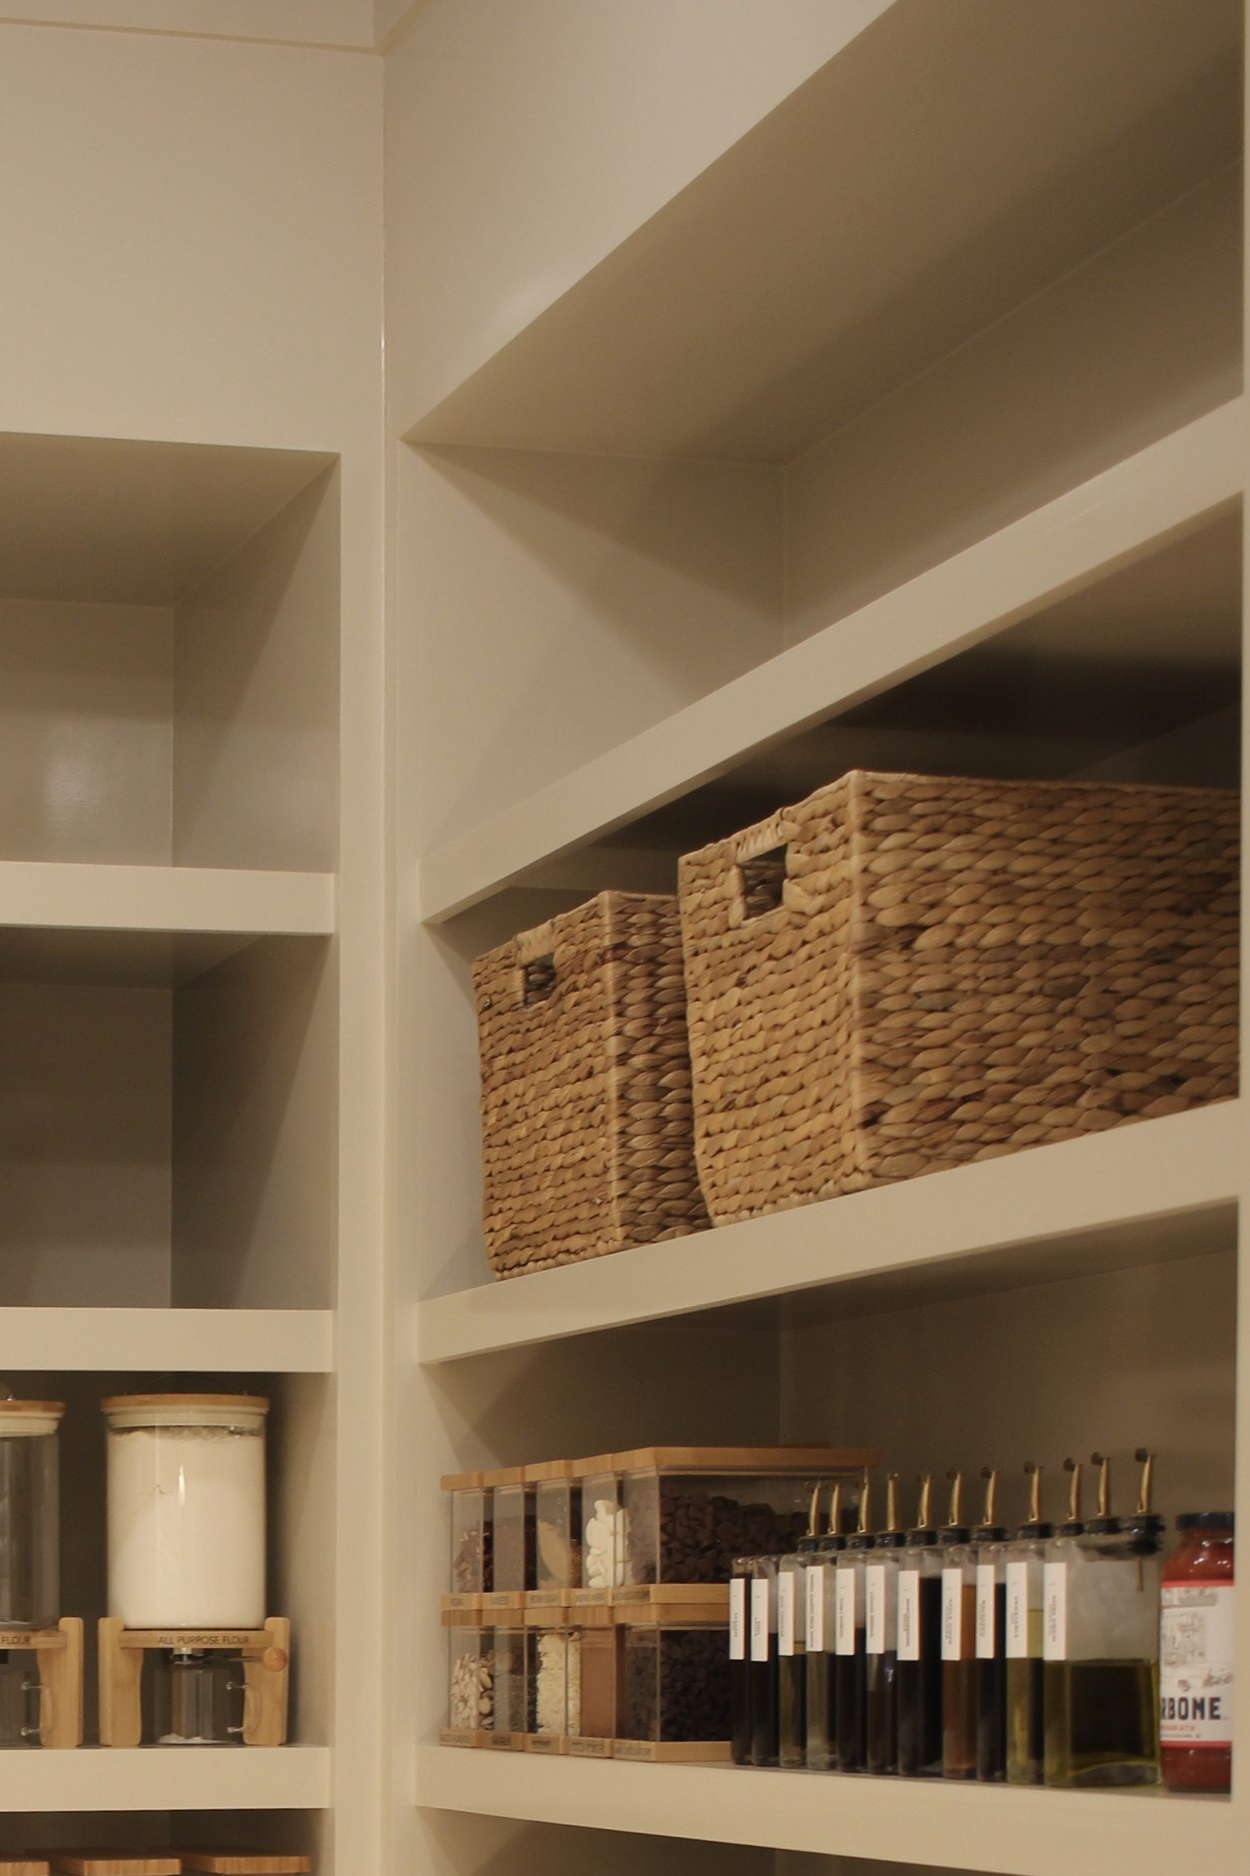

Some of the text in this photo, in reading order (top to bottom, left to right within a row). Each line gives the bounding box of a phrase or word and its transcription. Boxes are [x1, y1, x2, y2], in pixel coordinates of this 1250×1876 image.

[2, 1636, 31, 1645] FLOUR
[158, 1636, 250, 1645] ALL PURPOSE FLOUR
